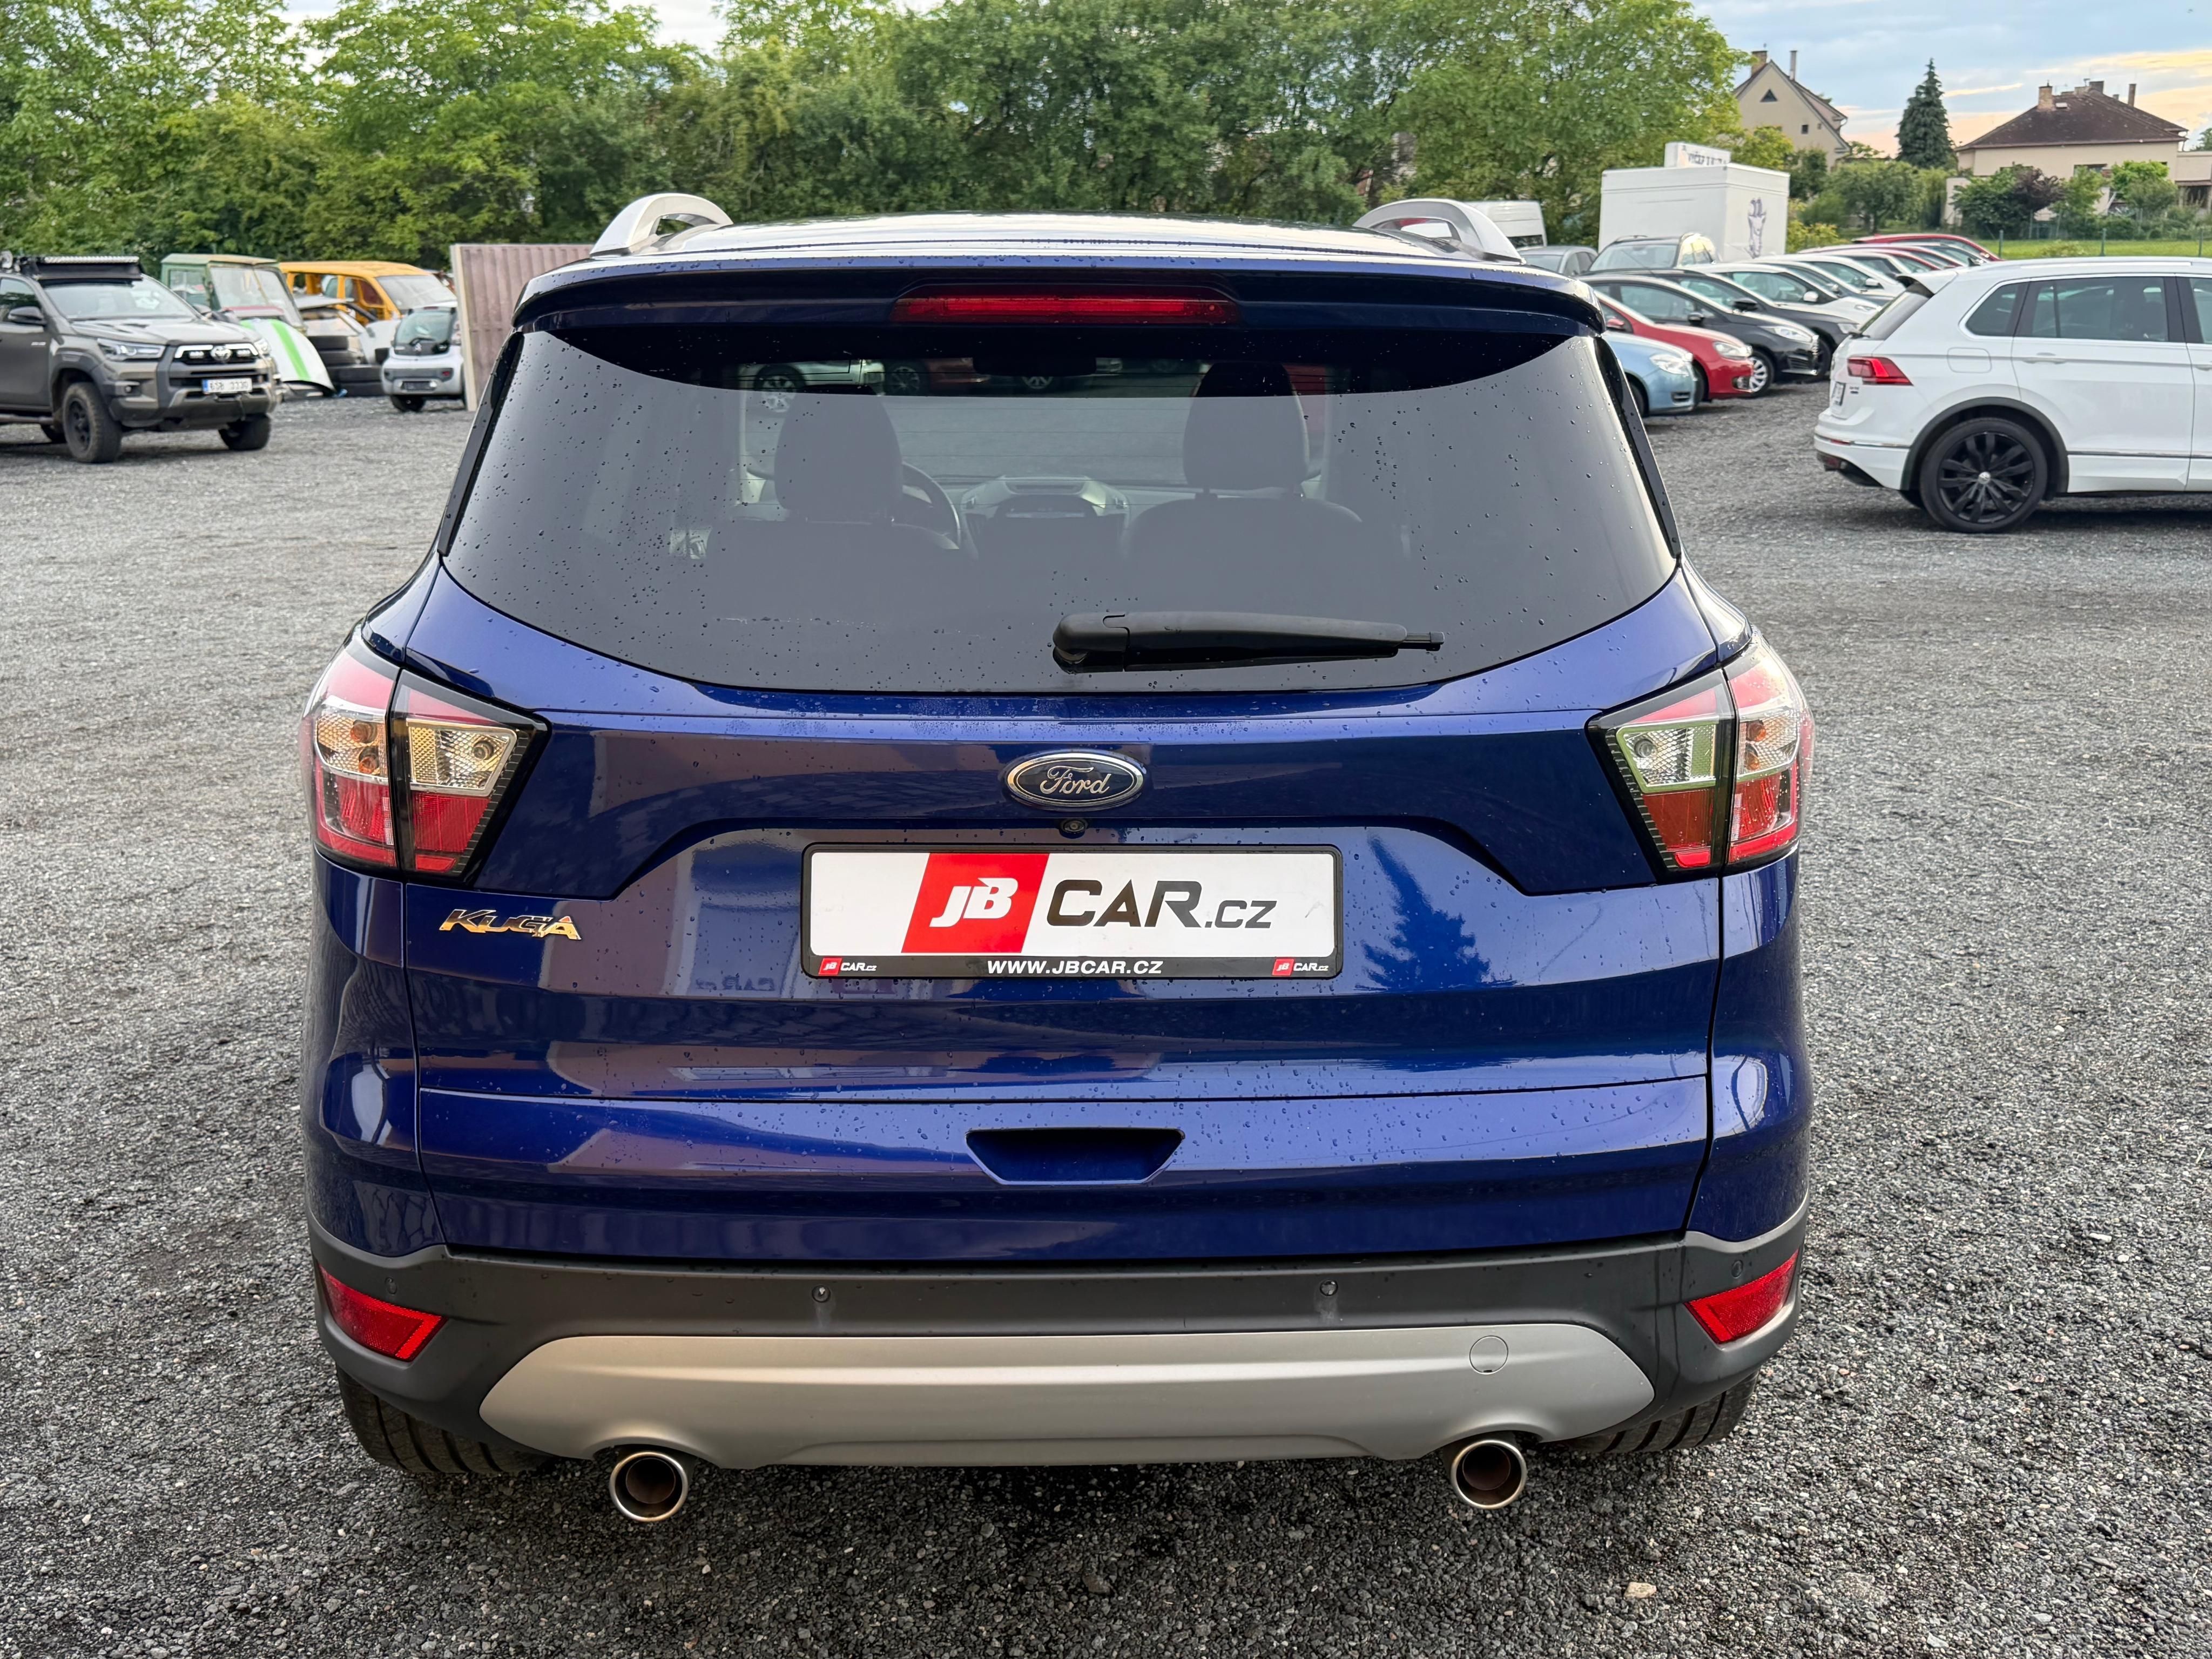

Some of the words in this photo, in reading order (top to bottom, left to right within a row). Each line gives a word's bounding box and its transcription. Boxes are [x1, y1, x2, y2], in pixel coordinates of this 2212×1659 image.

[1040, 765, 1111, 794] Ford
[929, 878, 1019, 927] JB
[439, 908, 582, 940] KUGA
[987, 961, 1164, 974] WWW.JBCAR.CZ
